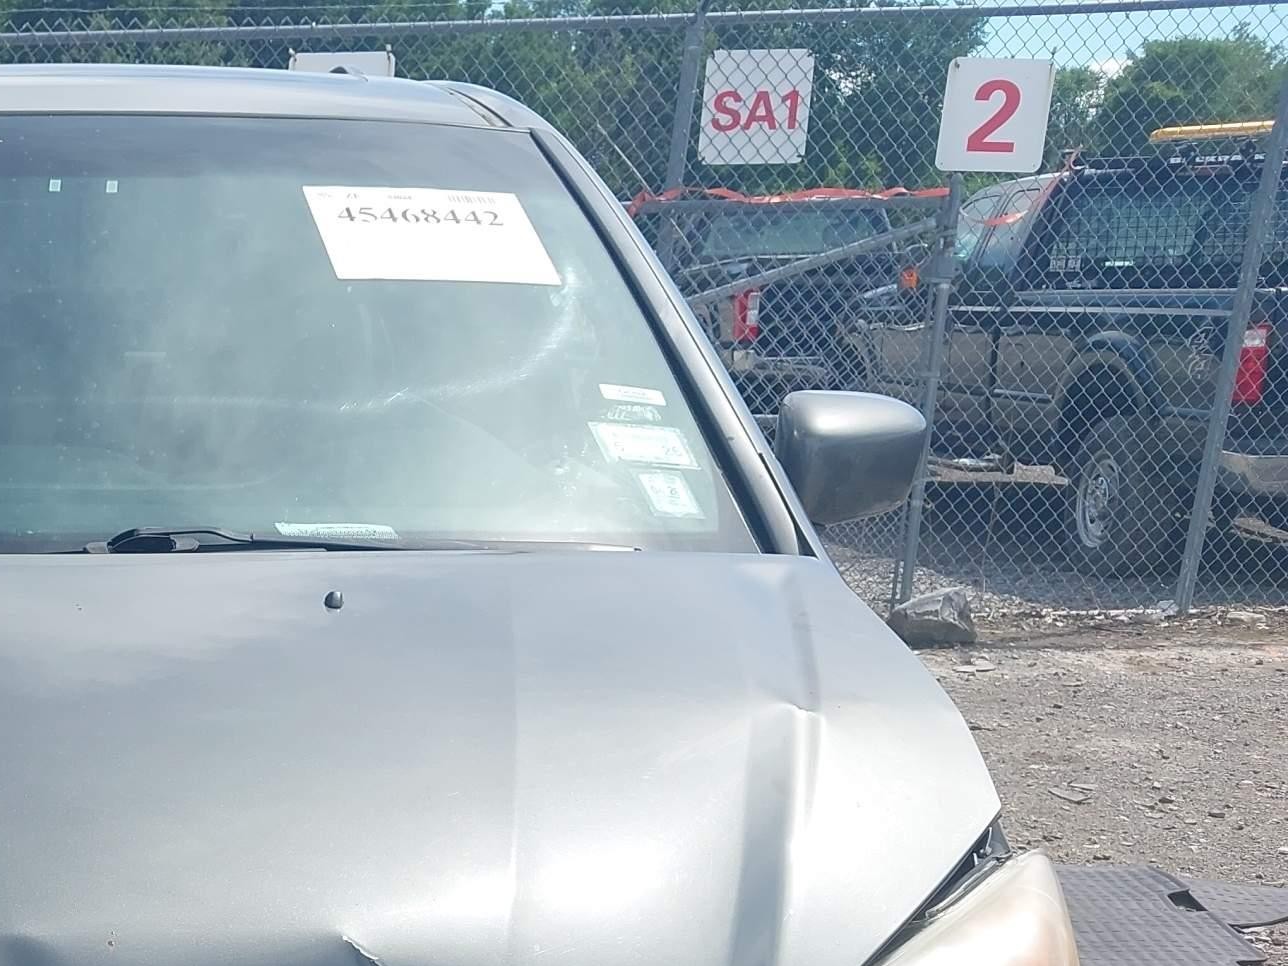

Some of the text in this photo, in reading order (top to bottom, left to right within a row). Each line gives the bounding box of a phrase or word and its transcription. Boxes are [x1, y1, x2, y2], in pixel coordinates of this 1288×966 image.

[712, 90, 800, 132] SA1
[966, 79, 1022, 153] 2
[337, 206, 505, 227] 45468442
